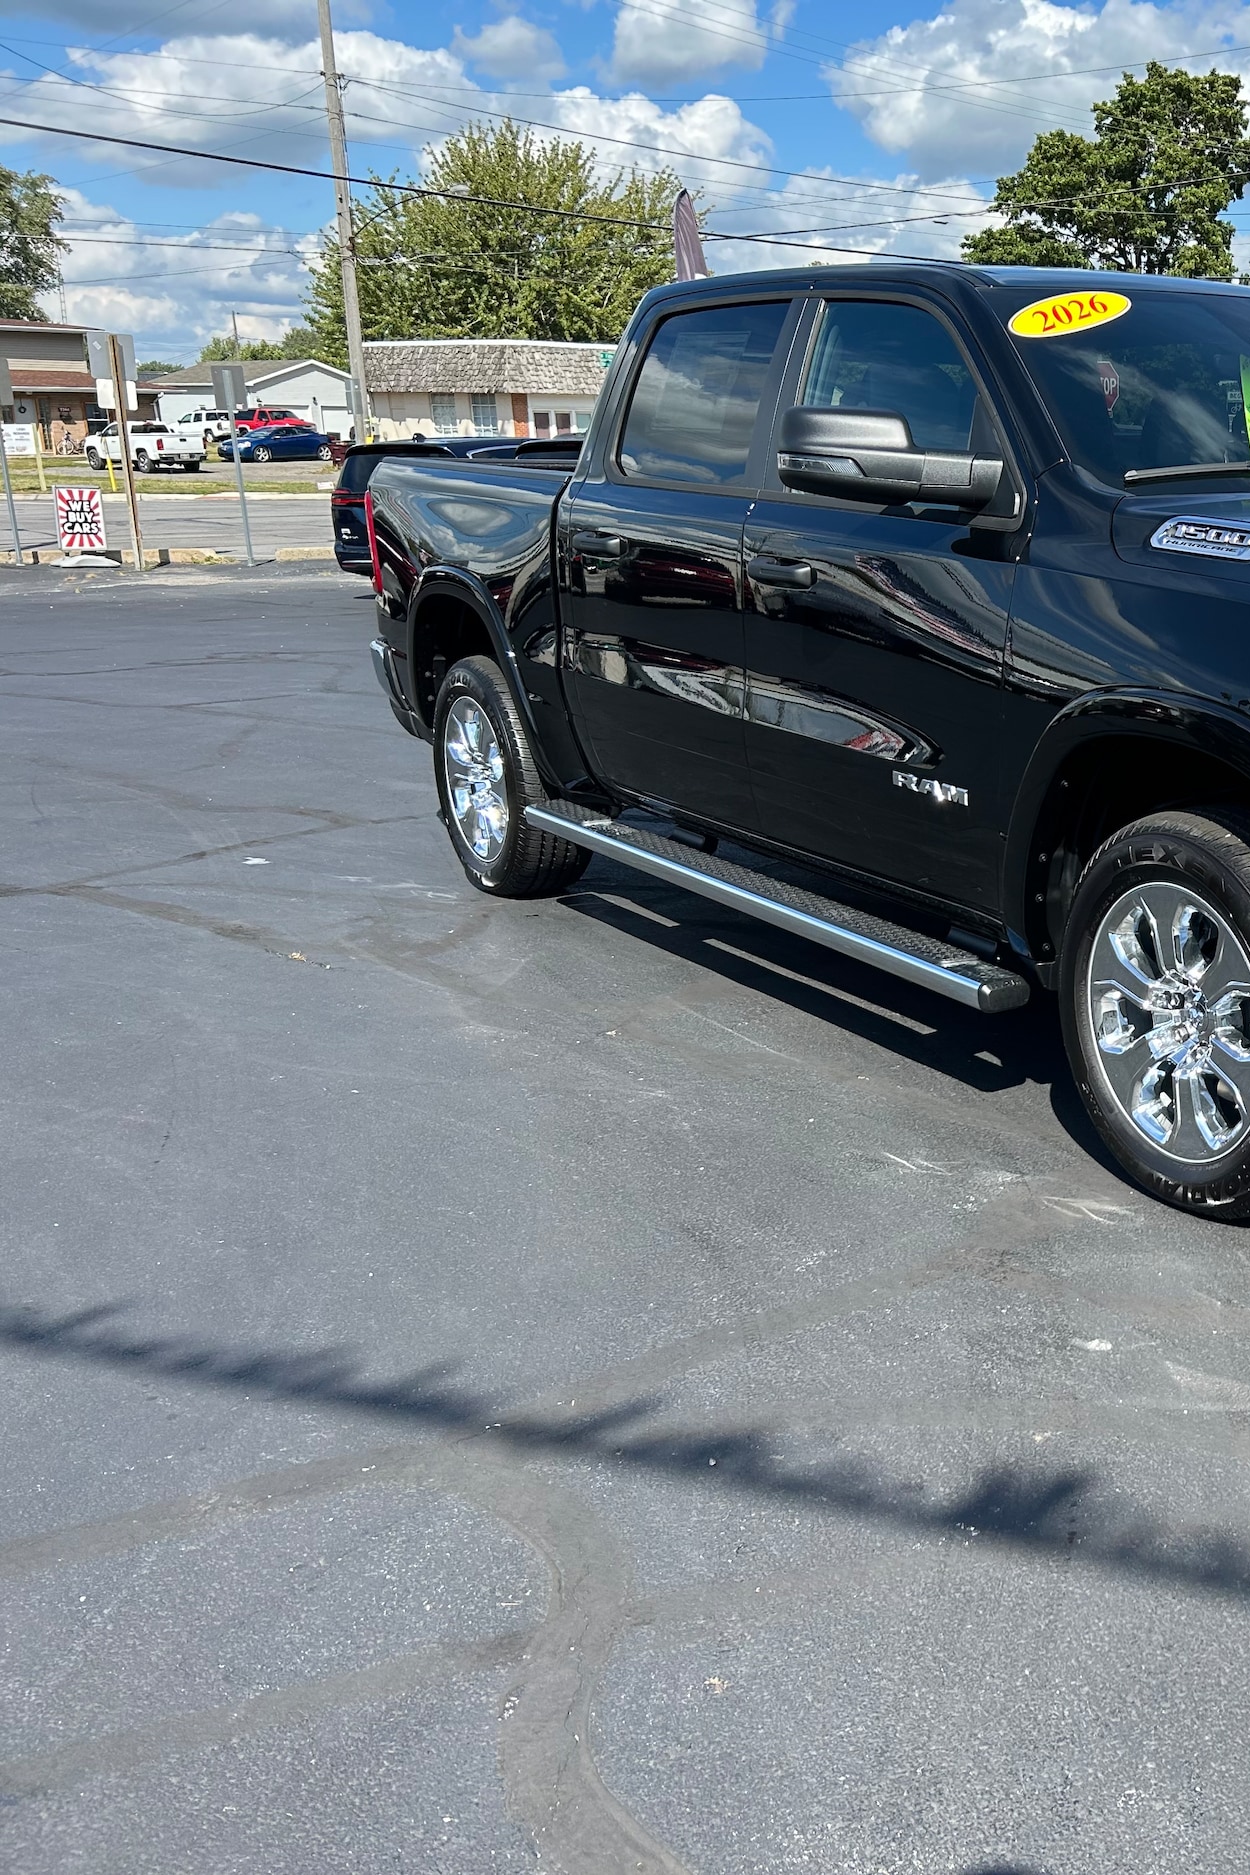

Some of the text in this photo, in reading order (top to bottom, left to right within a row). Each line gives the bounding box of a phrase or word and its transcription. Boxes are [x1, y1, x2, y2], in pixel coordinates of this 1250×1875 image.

[1032, 295, 1108, 332] 2026
[1099, 377, 1117, 395] TOP
[67, 500, 91, 512] WE
[67, 511, 93, 523] BUY
[63, 522, 99, 534] CARS
[1166, 539, 1237, 553] HURRICANE
[892, 770, 969, 807] RAM
